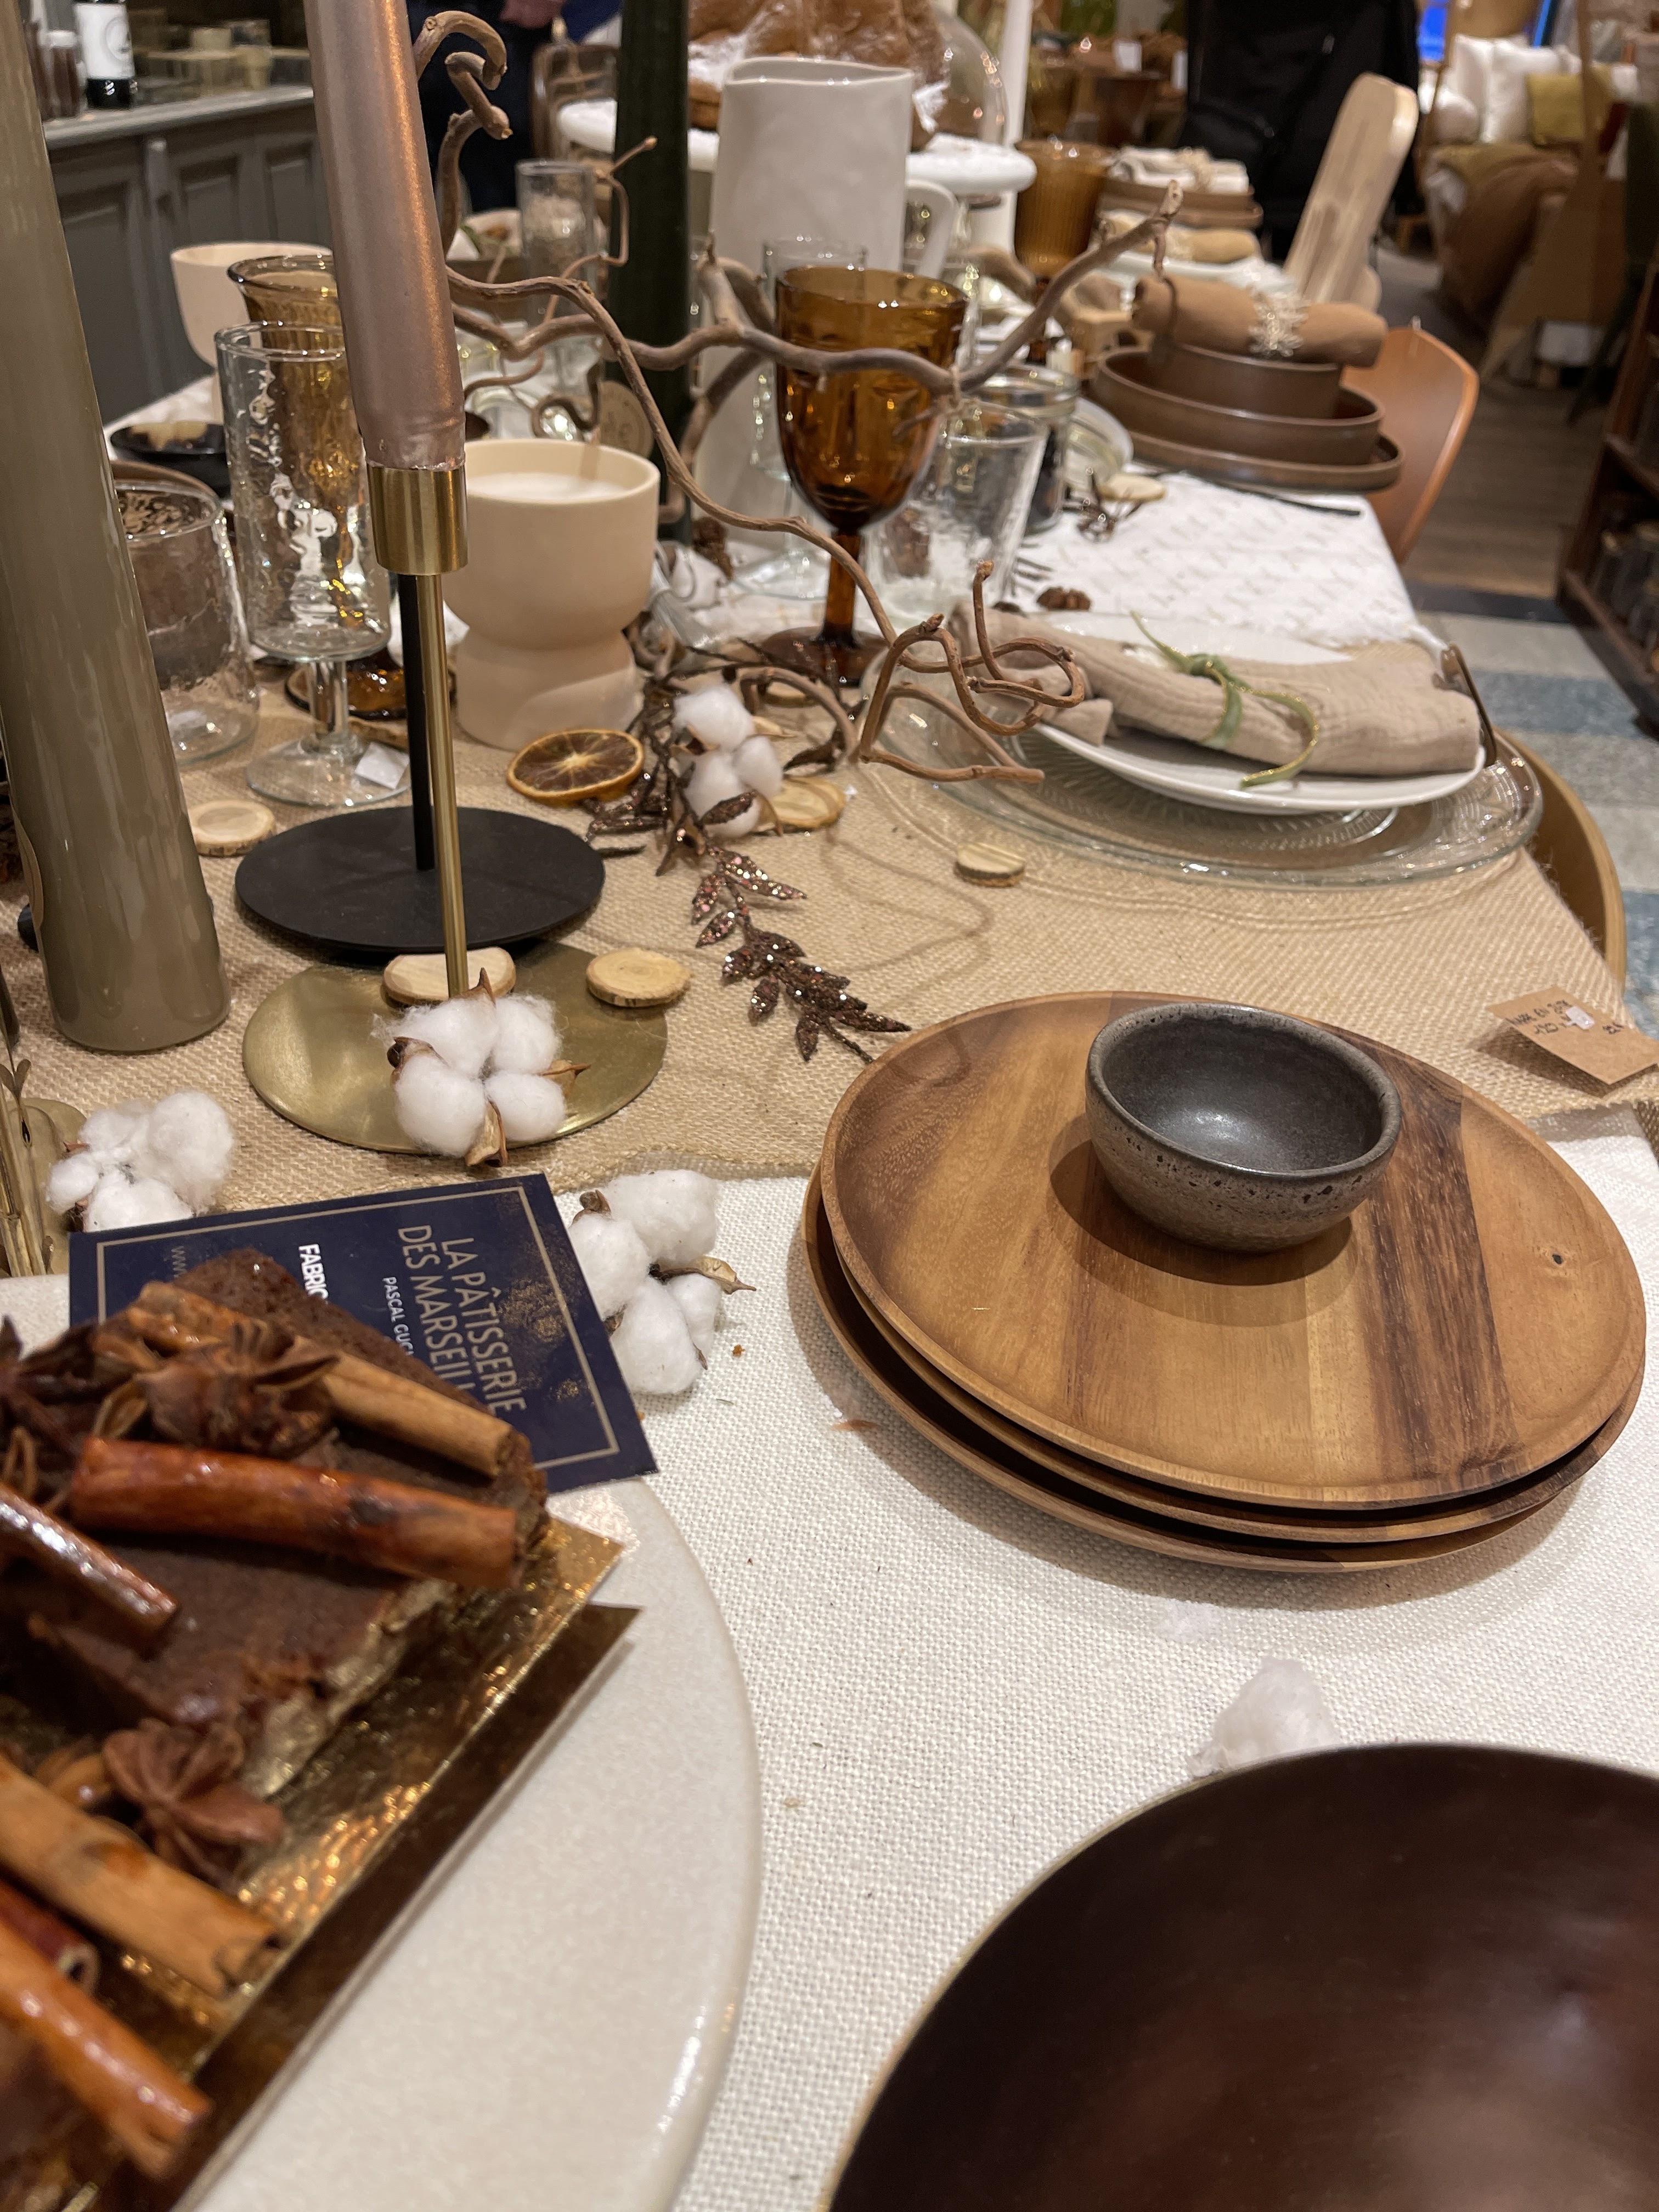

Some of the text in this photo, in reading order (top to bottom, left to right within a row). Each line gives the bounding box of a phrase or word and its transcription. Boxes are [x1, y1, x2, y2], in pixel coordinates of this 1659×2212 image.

[398, 1224, 441, 1270] DES
[382, 1276, 406, 1323] PASCAL
[441, 1237, 527, 1417] LA PÂTISSERIE
